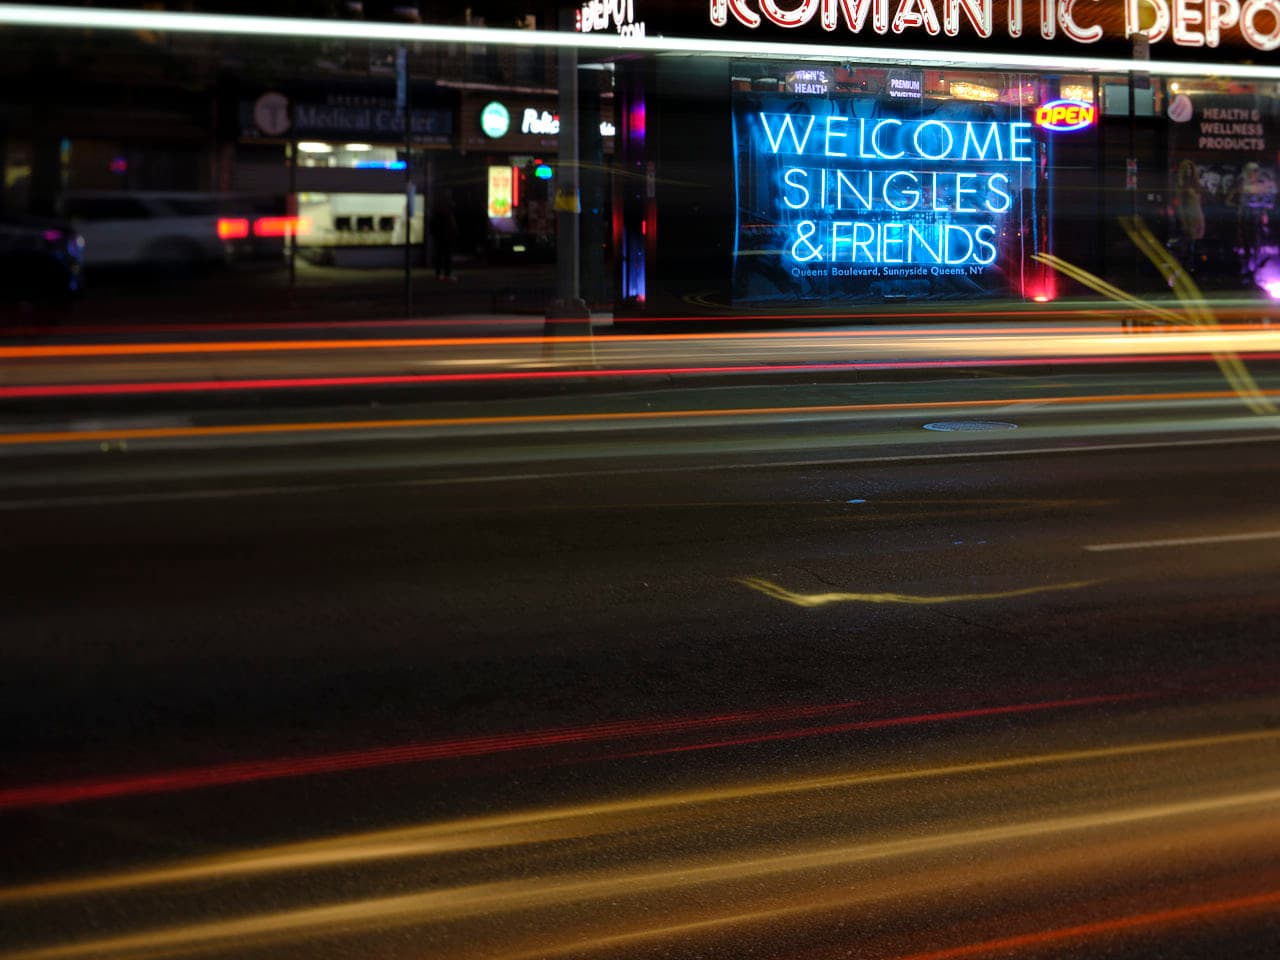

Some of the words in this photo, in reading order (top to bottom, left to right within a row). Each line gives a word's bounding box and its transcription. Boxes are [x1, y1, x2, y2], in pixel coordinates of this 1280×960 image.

[794, 82, 829, 95] HEALTH
[890, 78, 920, 90] PREMIUM
[295, 105, 372, 129] Medical
[1035, 106, 1095, 125] OPEN
[1203, 108, 1249, 121] HEALTH
[1200, 122, 1264, 136] WELLNESS
[759, 111, 1034, 163] WELCOME
[1199, 137, 1265, 151] PRODUCTS
[783, 167, 1011, 214] SINGLES
[791, 267, 828, 277] Queens
[831, 267, 881, 277] Boulevard,
[883, 266, 928, 279] Sunnyside
[930, 266, 967, 277] Queens,
[969, 266, 984, 276] NY
